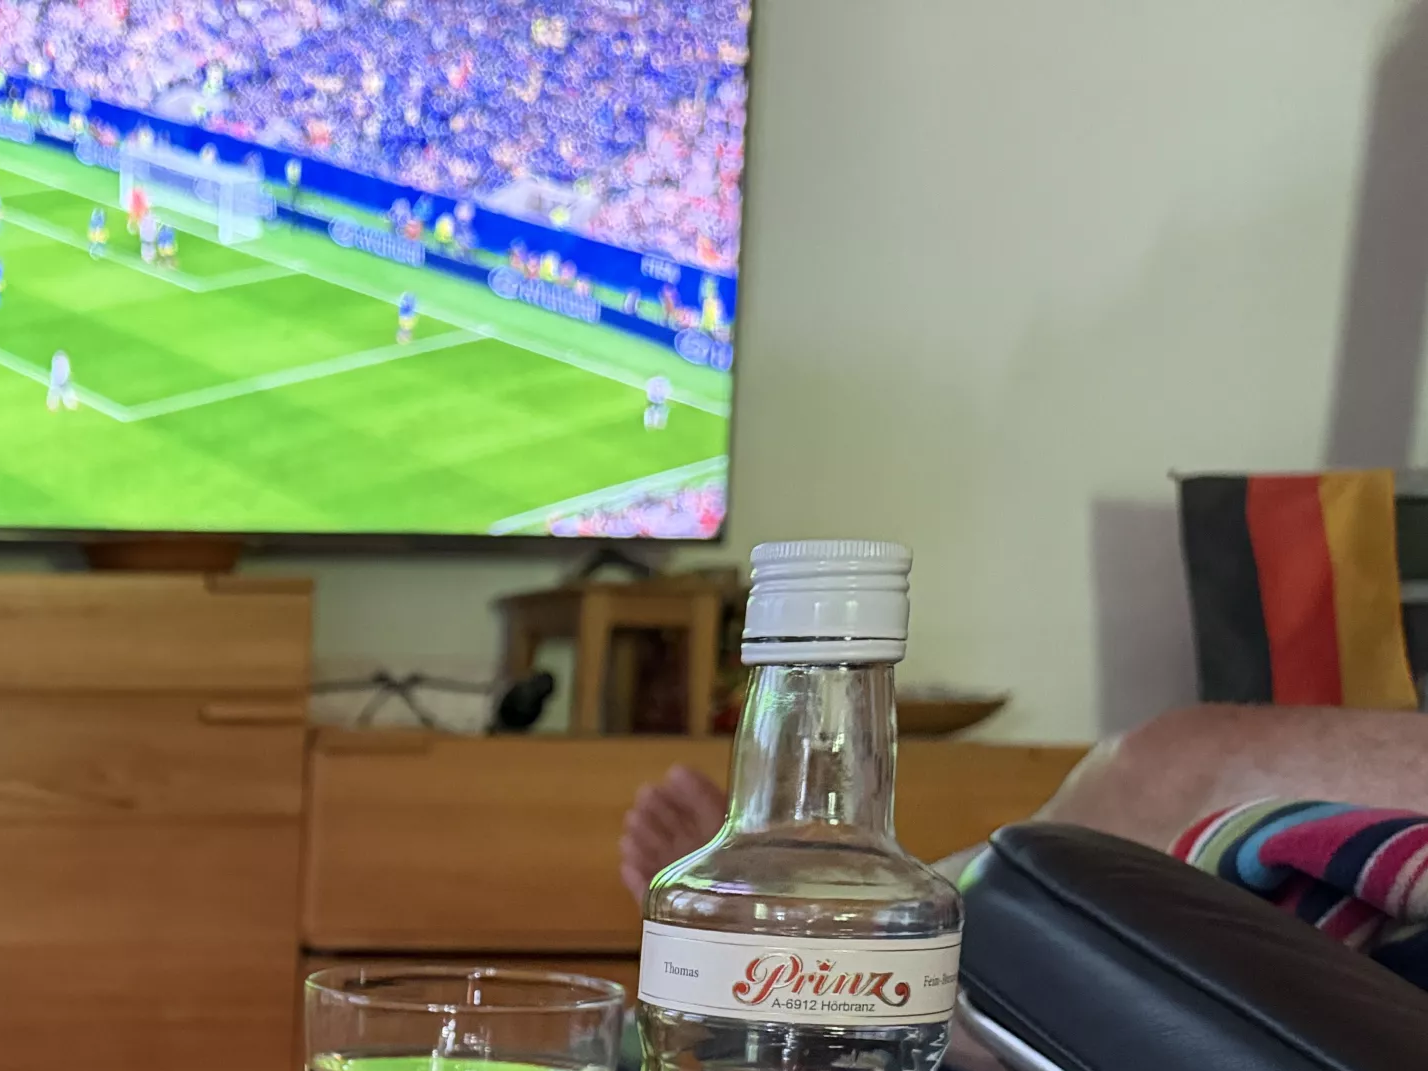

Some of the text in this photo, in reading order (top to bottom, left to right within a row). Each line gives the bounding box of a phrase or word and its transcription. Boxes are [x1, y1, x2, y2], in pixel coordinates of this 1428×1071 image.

[663, 961, 699, 978] Thomas
[732, 952, 911, 1006] Prinz
[771, 998, 876, 1013] A-6912 Hörbranz
